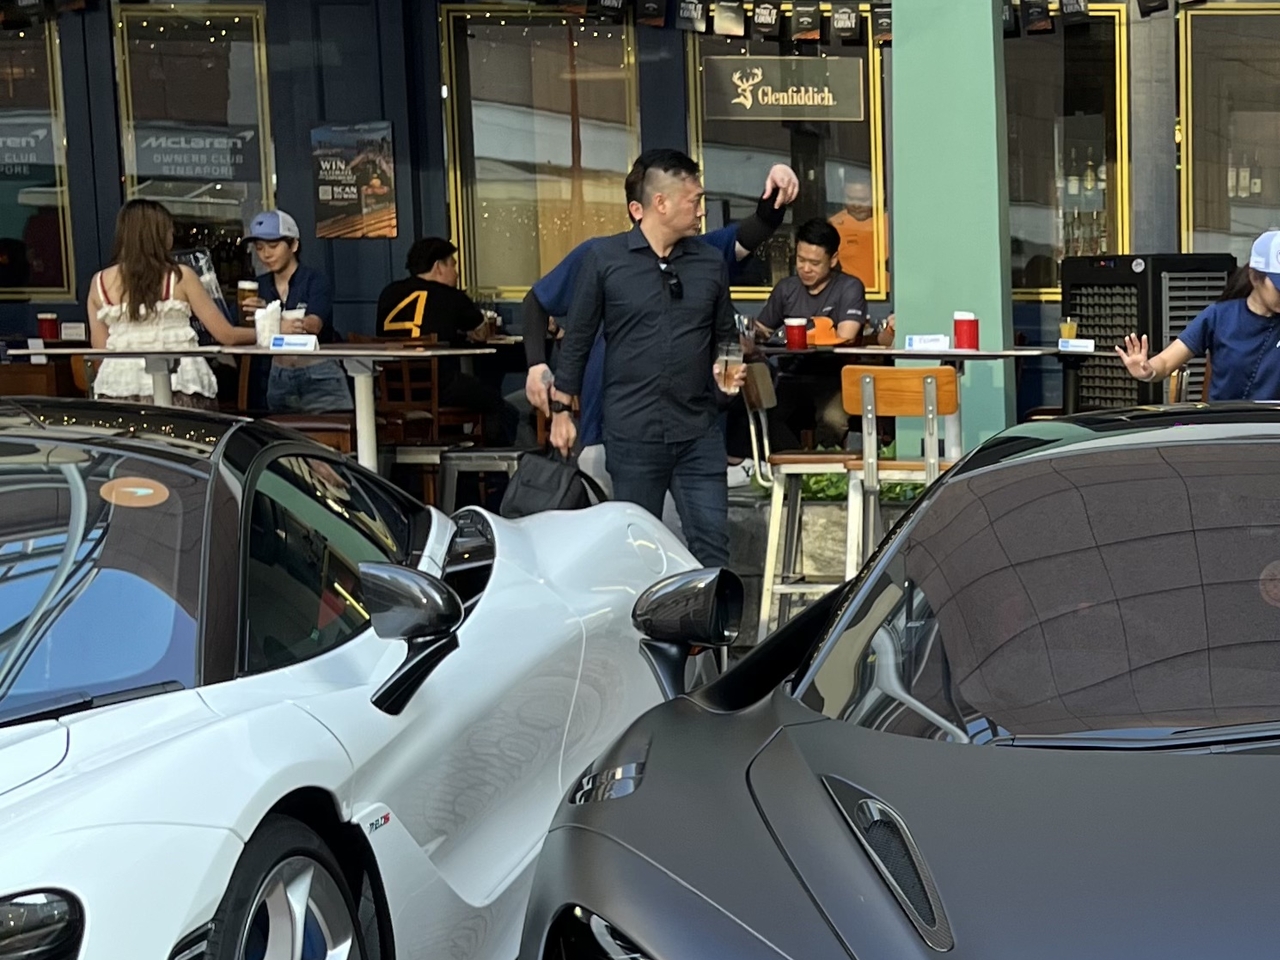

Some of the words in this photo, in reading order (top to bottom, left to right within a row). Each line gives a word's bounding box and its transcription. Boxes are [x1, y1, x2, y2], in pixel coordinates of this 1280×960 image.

[754, 15, 777, 25] COUNT
[834, 20, 856, 29] COUNT
[757, 85, 834, 106] Glenfiddich
[140, 133, 243, 149] McLaren
[153, 153, 208, 164] OWNERS
[211, 154, 244, 165] CLUB
[320, 159, 346, 170] WIN
[162, 164, 236, 176] SINGAPORE
[333, 185, 358, 194] SCAN
[384, 290, 428, 339] 4
